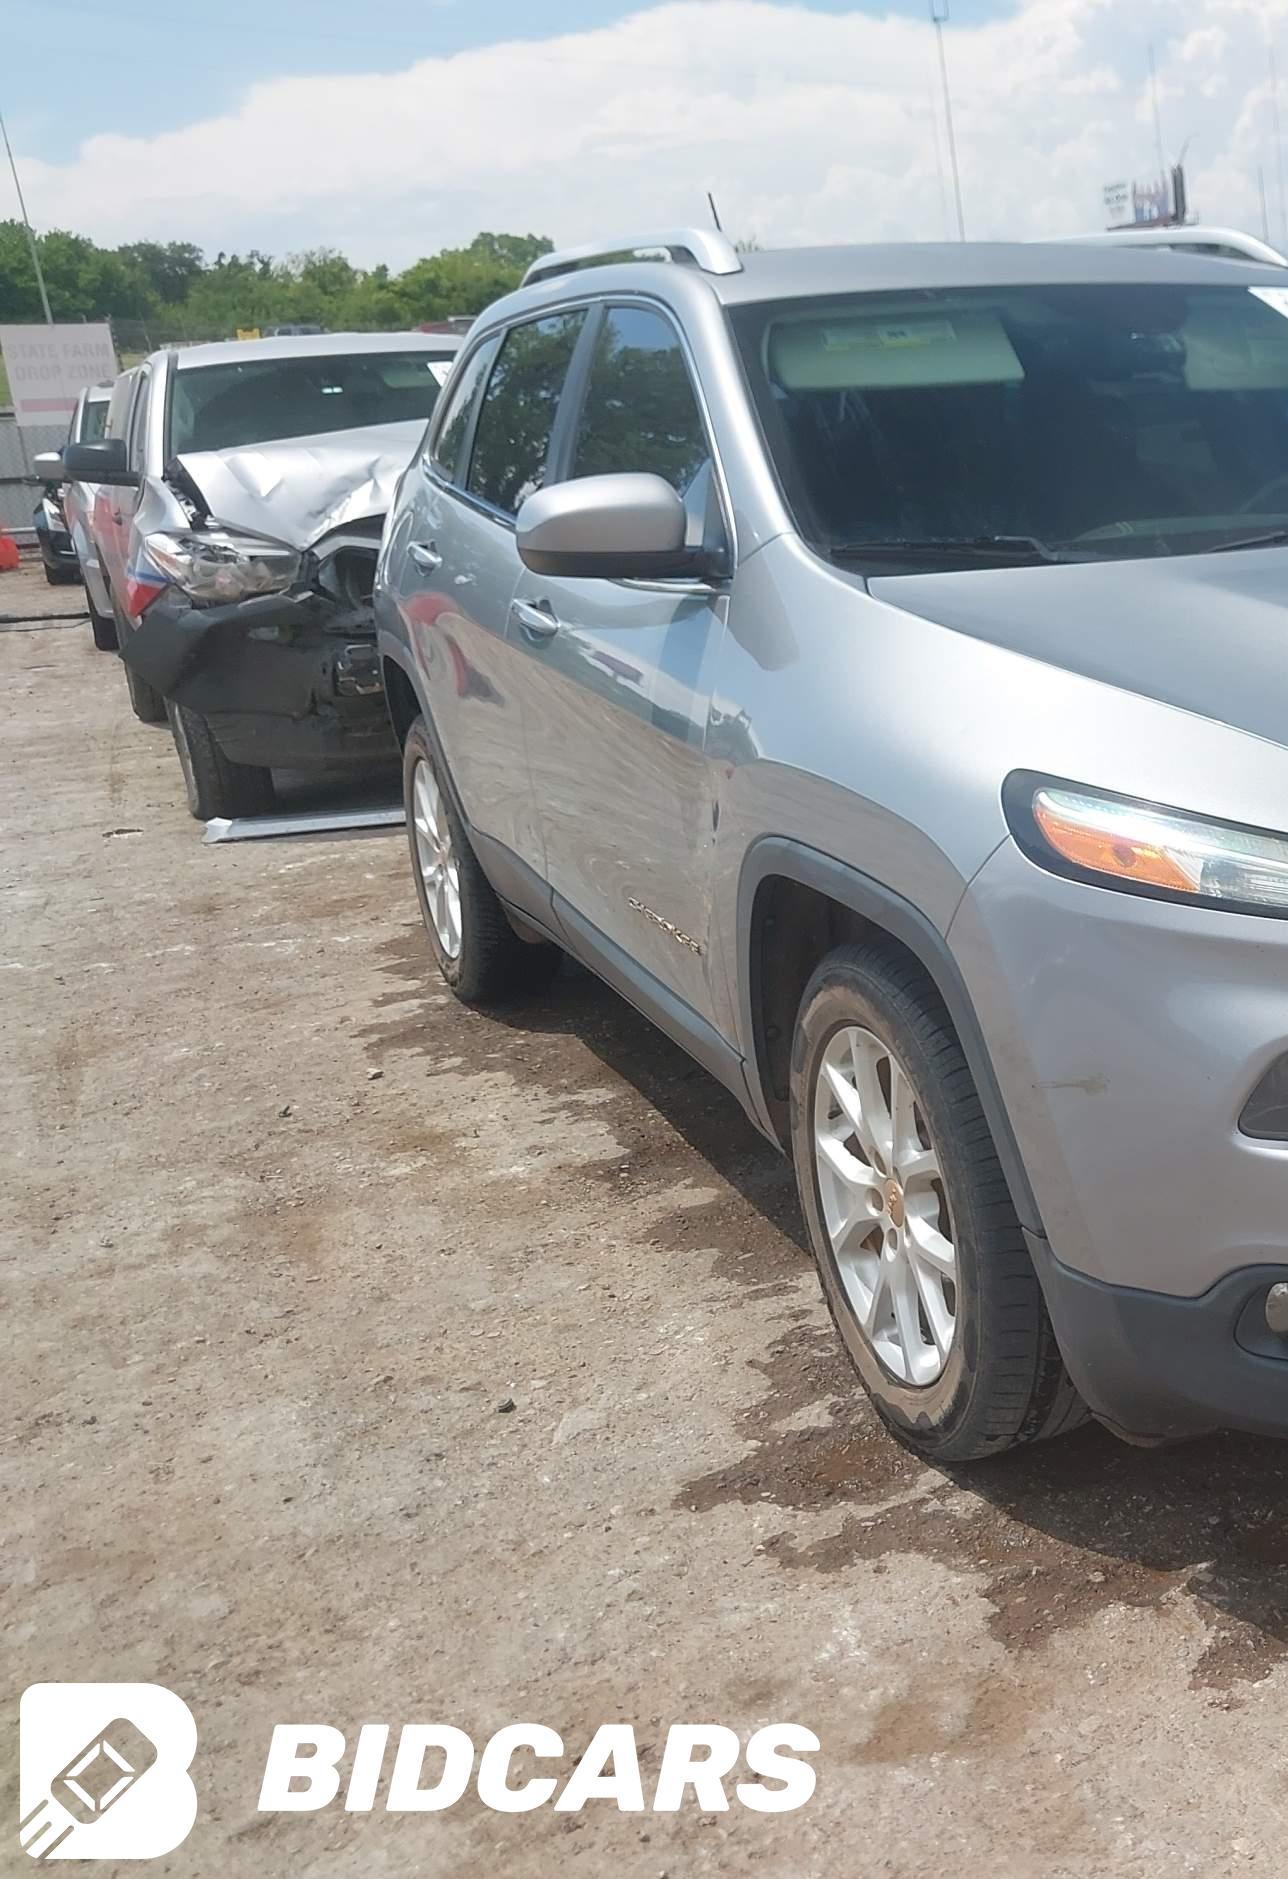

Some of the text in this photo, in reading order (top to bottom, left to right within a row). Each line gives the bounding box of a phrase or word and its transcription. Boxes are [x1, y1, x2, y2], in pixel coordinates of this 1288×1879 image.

[8, 343, 110, 360] STATE FARM
[15, 365, 112, 381] DROP ZONE
